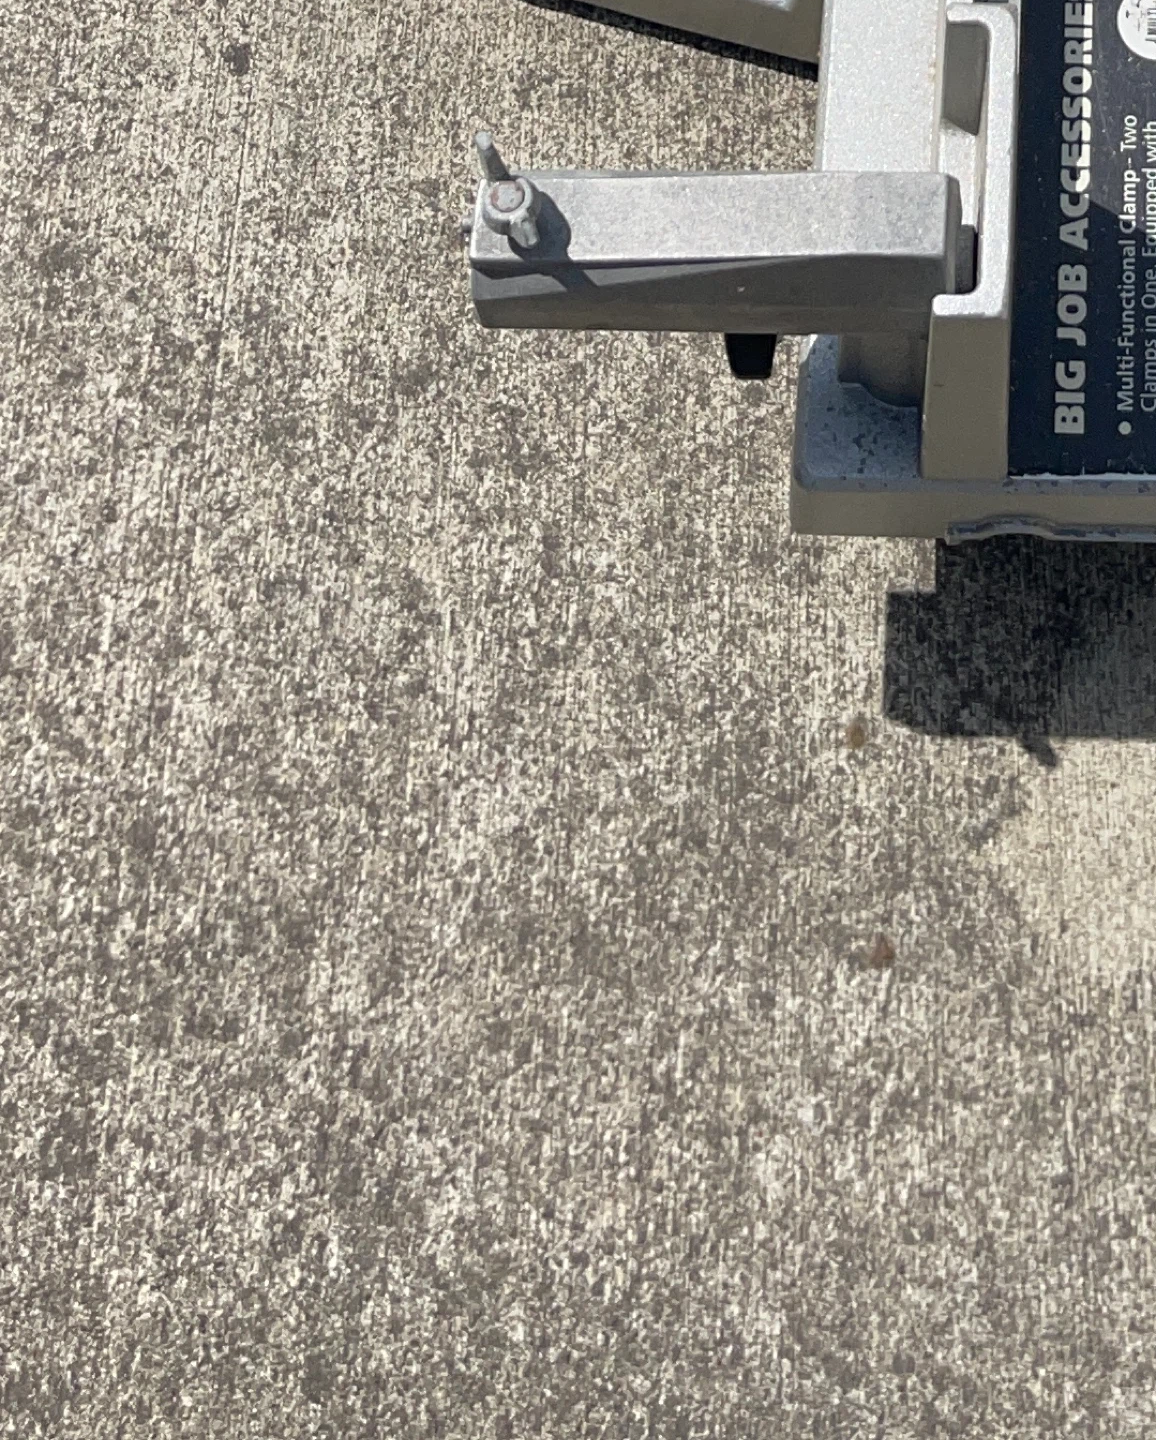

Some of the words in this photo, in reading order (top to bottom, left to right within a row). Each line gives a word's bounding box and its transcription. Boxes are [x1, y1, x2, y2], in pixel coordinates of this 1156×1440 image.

[1121, 115, 1137, 151] Two
[1119, 170, 1140, 234] Clamp
[1057, 264, 1087, 346] JOB
[1116, 240, 1136, 411] Multi-Functional
[1054, 360, 1086, 434] BIG
